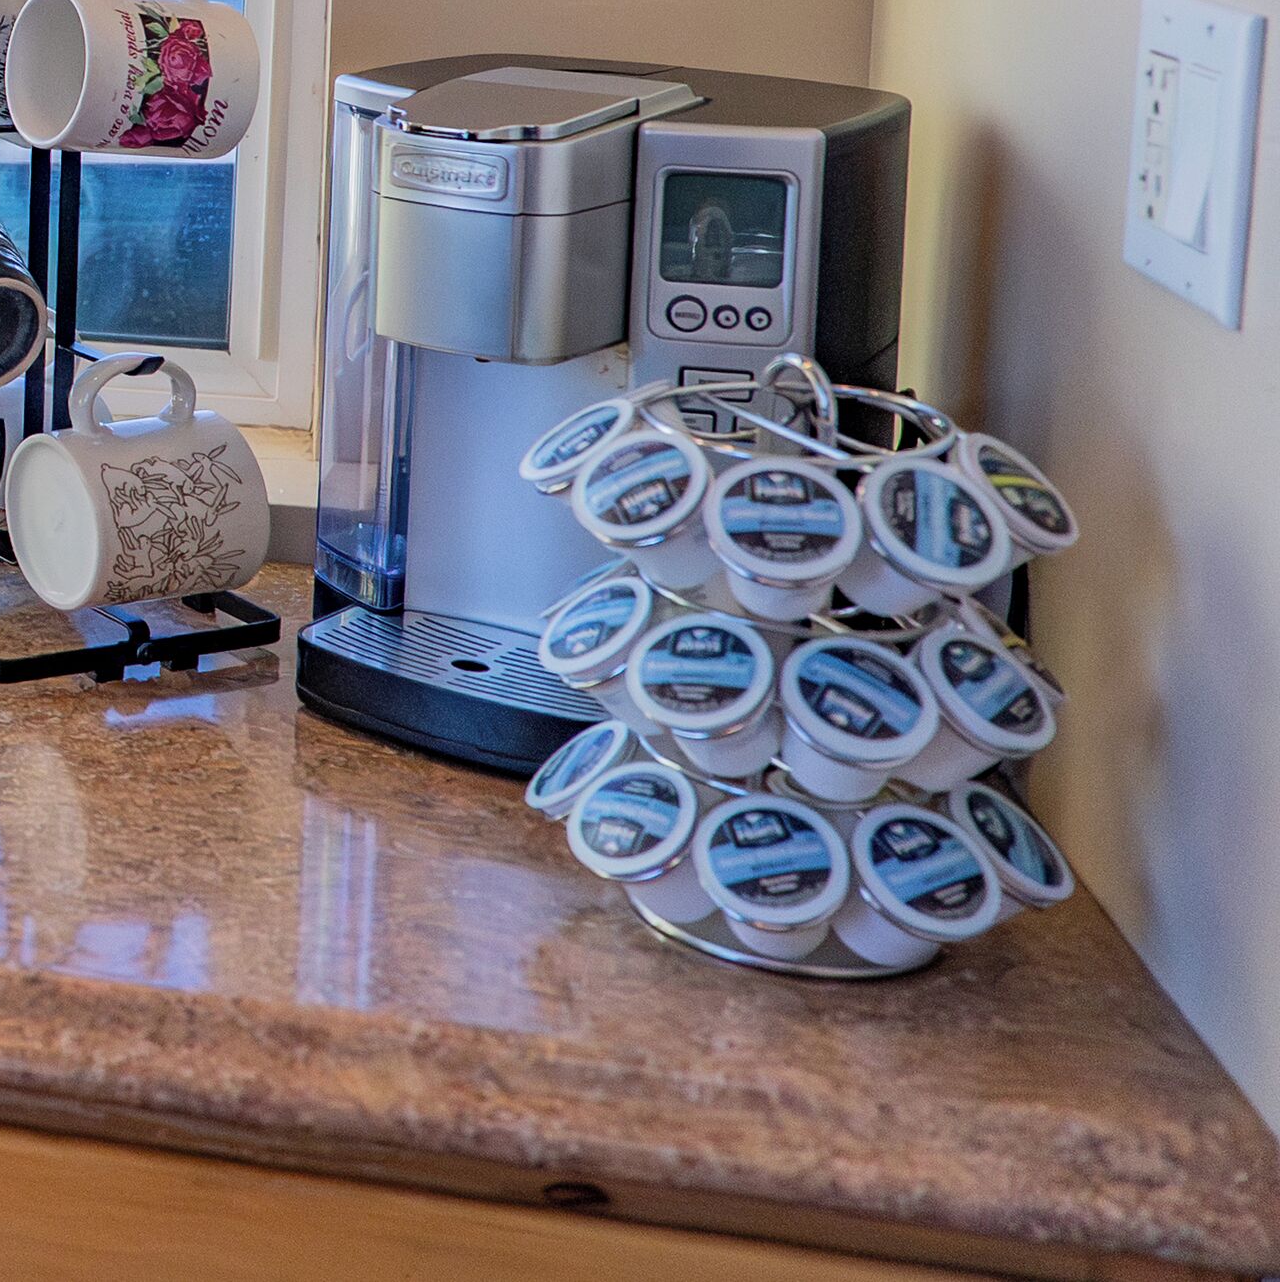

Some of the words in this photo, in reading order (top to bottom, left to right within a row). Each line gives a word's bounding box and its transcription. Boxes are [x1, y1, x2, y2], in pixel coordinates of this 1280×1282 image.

[115, 8, 143, 60] special
[123, 64, 145, 101] very
[119, 103, 130, 115] a
[182, 98, 229, 155] Mom
[108, 118, 124, 138] are
